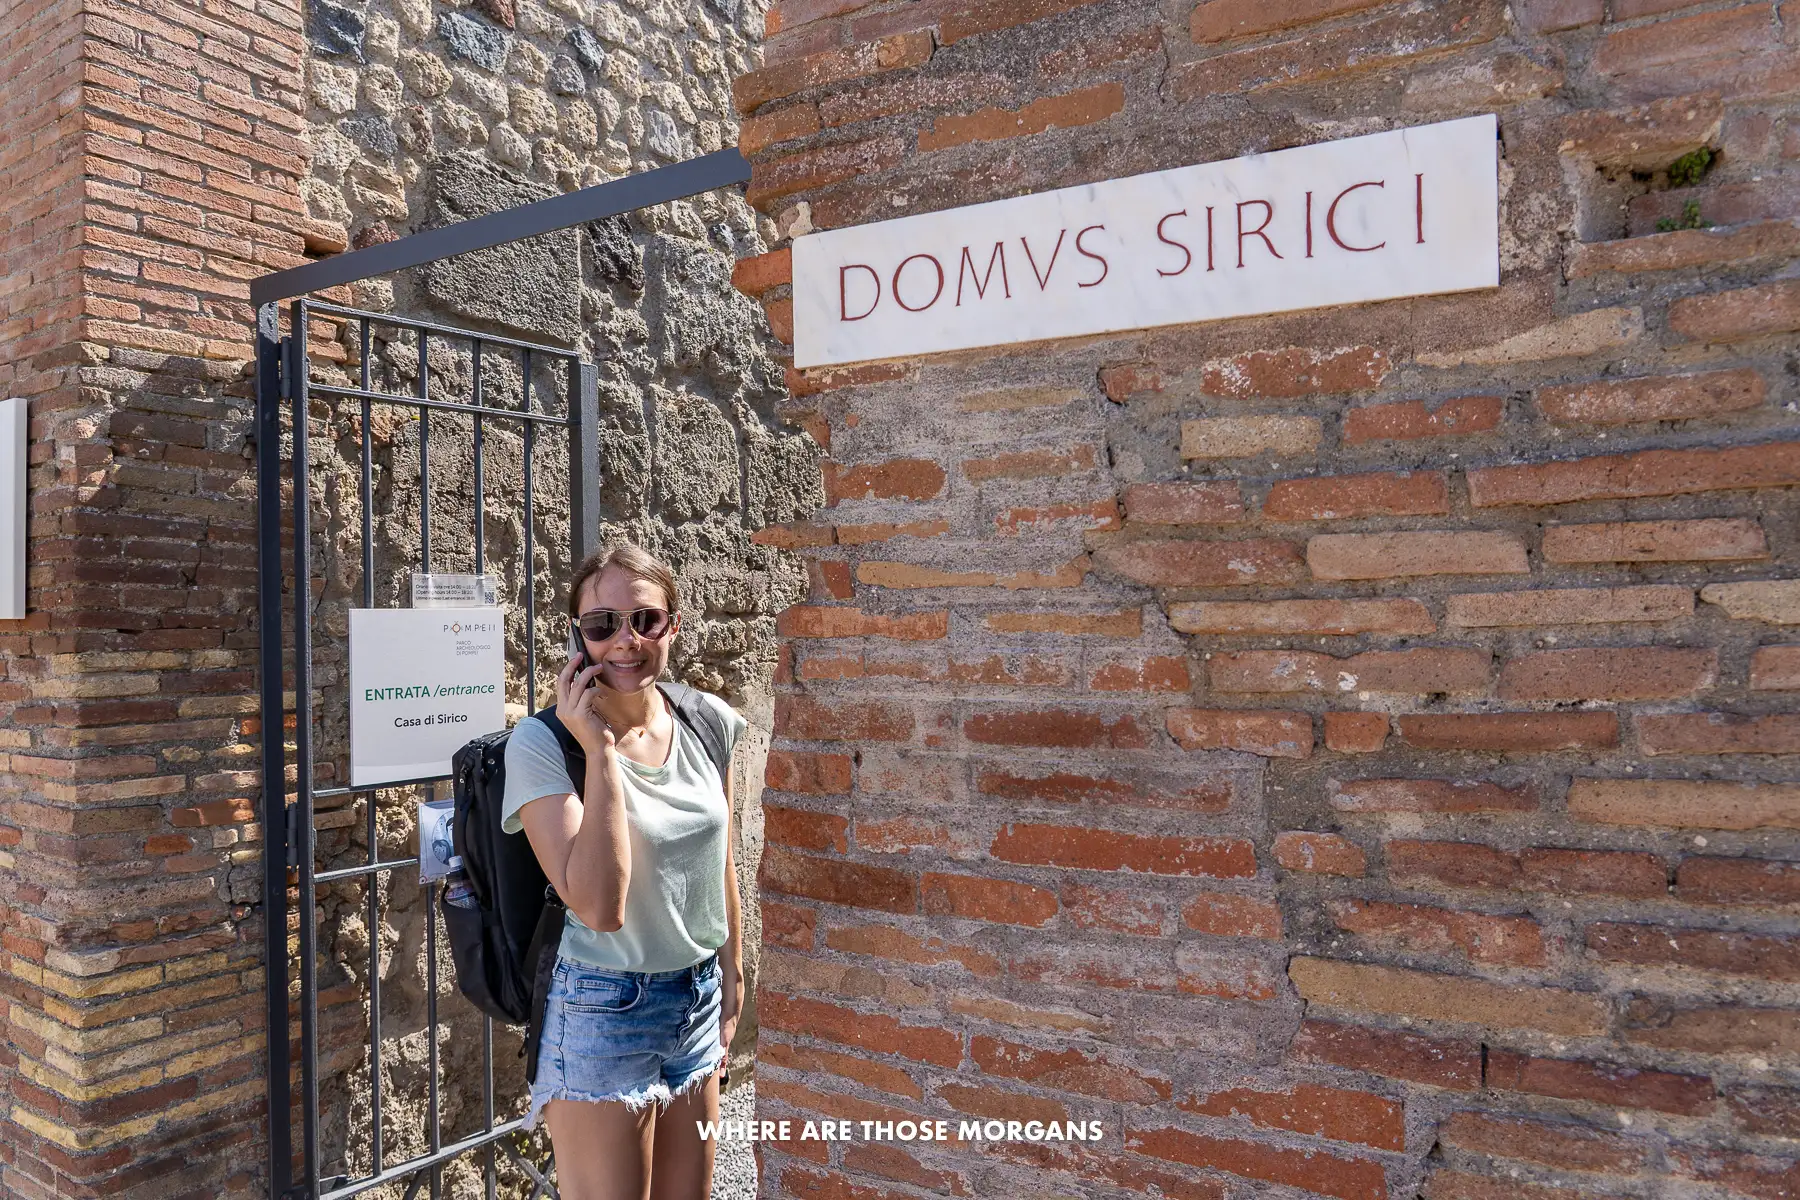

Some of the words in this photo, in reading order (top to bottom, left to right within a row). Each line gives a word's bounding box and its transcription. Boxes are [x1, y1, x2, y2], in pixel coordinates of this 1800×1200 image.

[838, 224, 1110, 322] DOMVS
[1157, 172, 1426, 277] SIRICI
[365, 686, 431, 701] ENTRATA
[394, 717, 421, 728] Casa
[424, 715, 435, 726] di
[437, 713, 468, 724] Sirico
